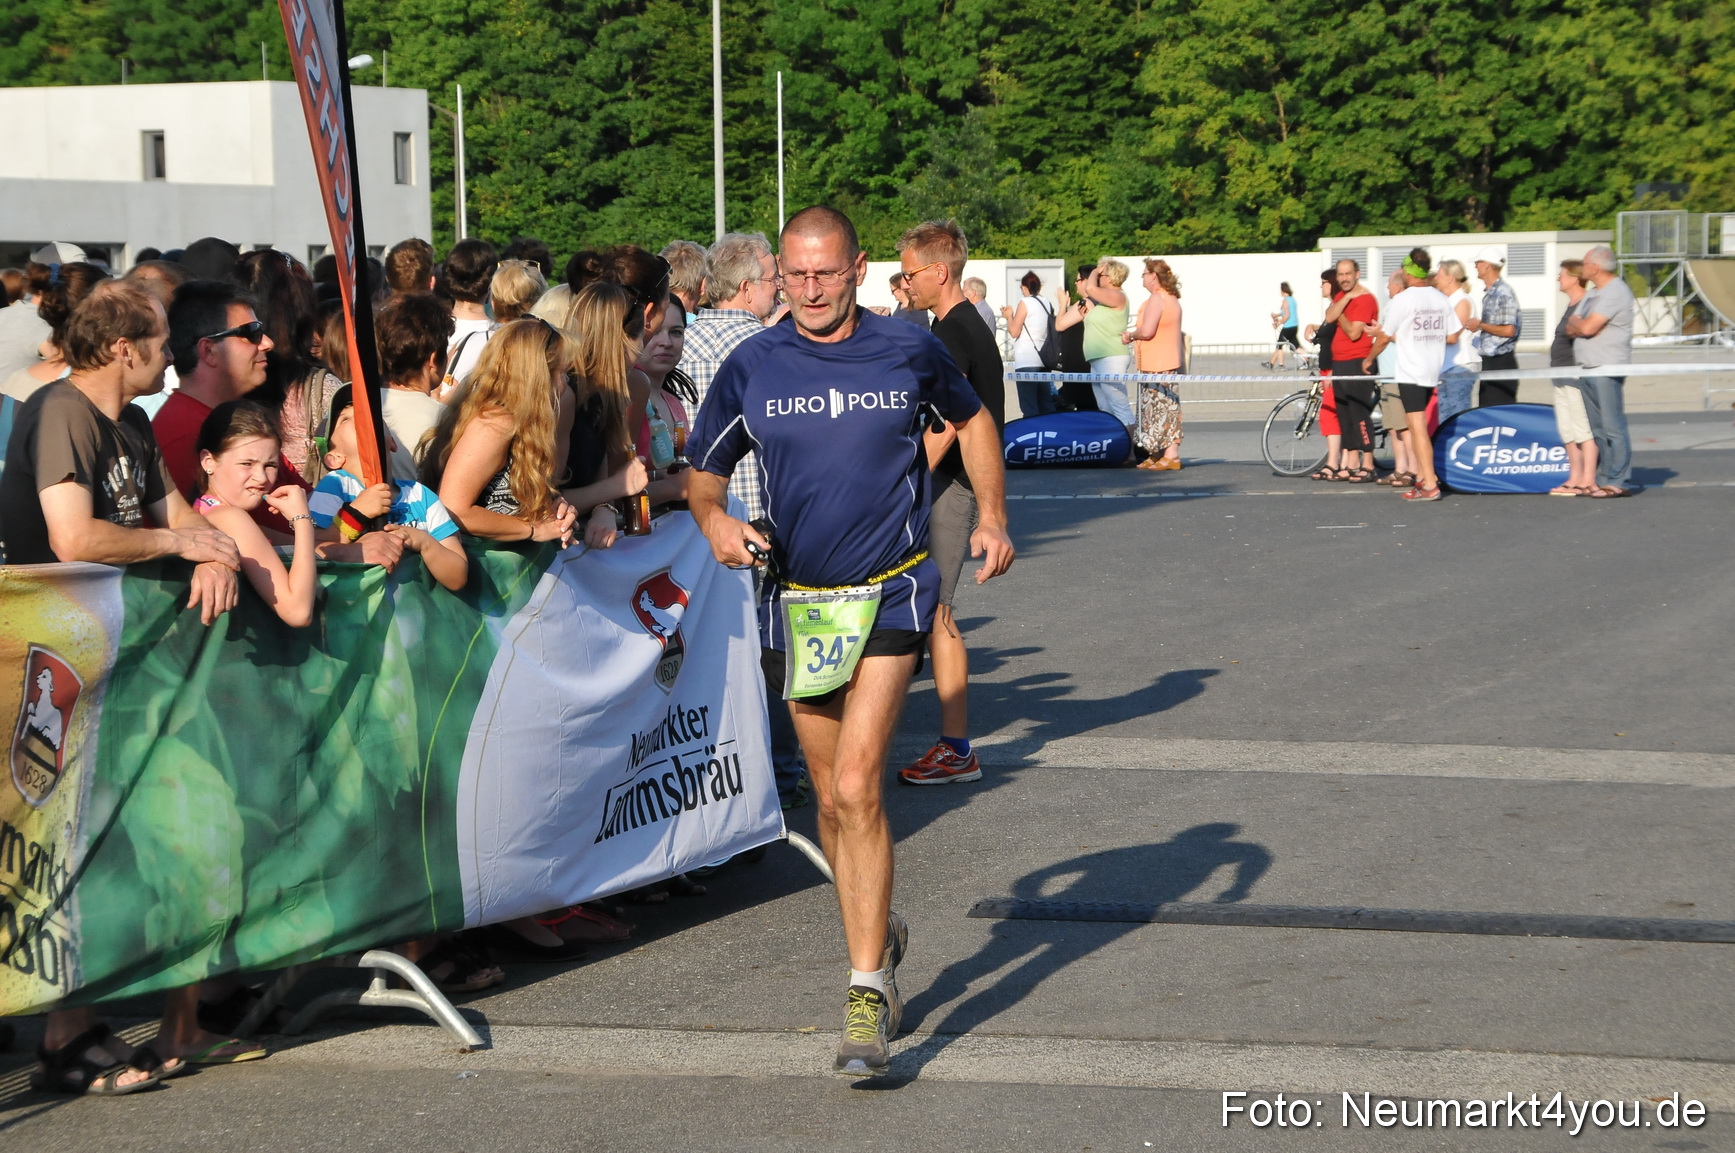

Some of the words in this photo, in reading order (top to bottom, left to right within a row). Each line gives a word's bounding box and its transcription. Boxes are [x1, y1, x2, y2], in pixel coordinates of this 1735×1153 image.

[1413, 316, 1444, 331] Seidl
[766, 397, 826, 418] EURO
[847, 391, 909, 412] POLES
[1023, 437, 1113, 461] Fischer
[1033, 453, 1107, 464] AUTOMOBILE
[1472, 441, 1569, 465] Fische
[1482, 463, 1571, 475] AUTOMOBILE
[806, 635, 860, 673] 347
[659, 660, 679, 682] 1628
[625, 703, 709, 774] Neumarkter
[20, 761, 48, 794] 1628
[593, 743, 744, 845] Lammsbräu
